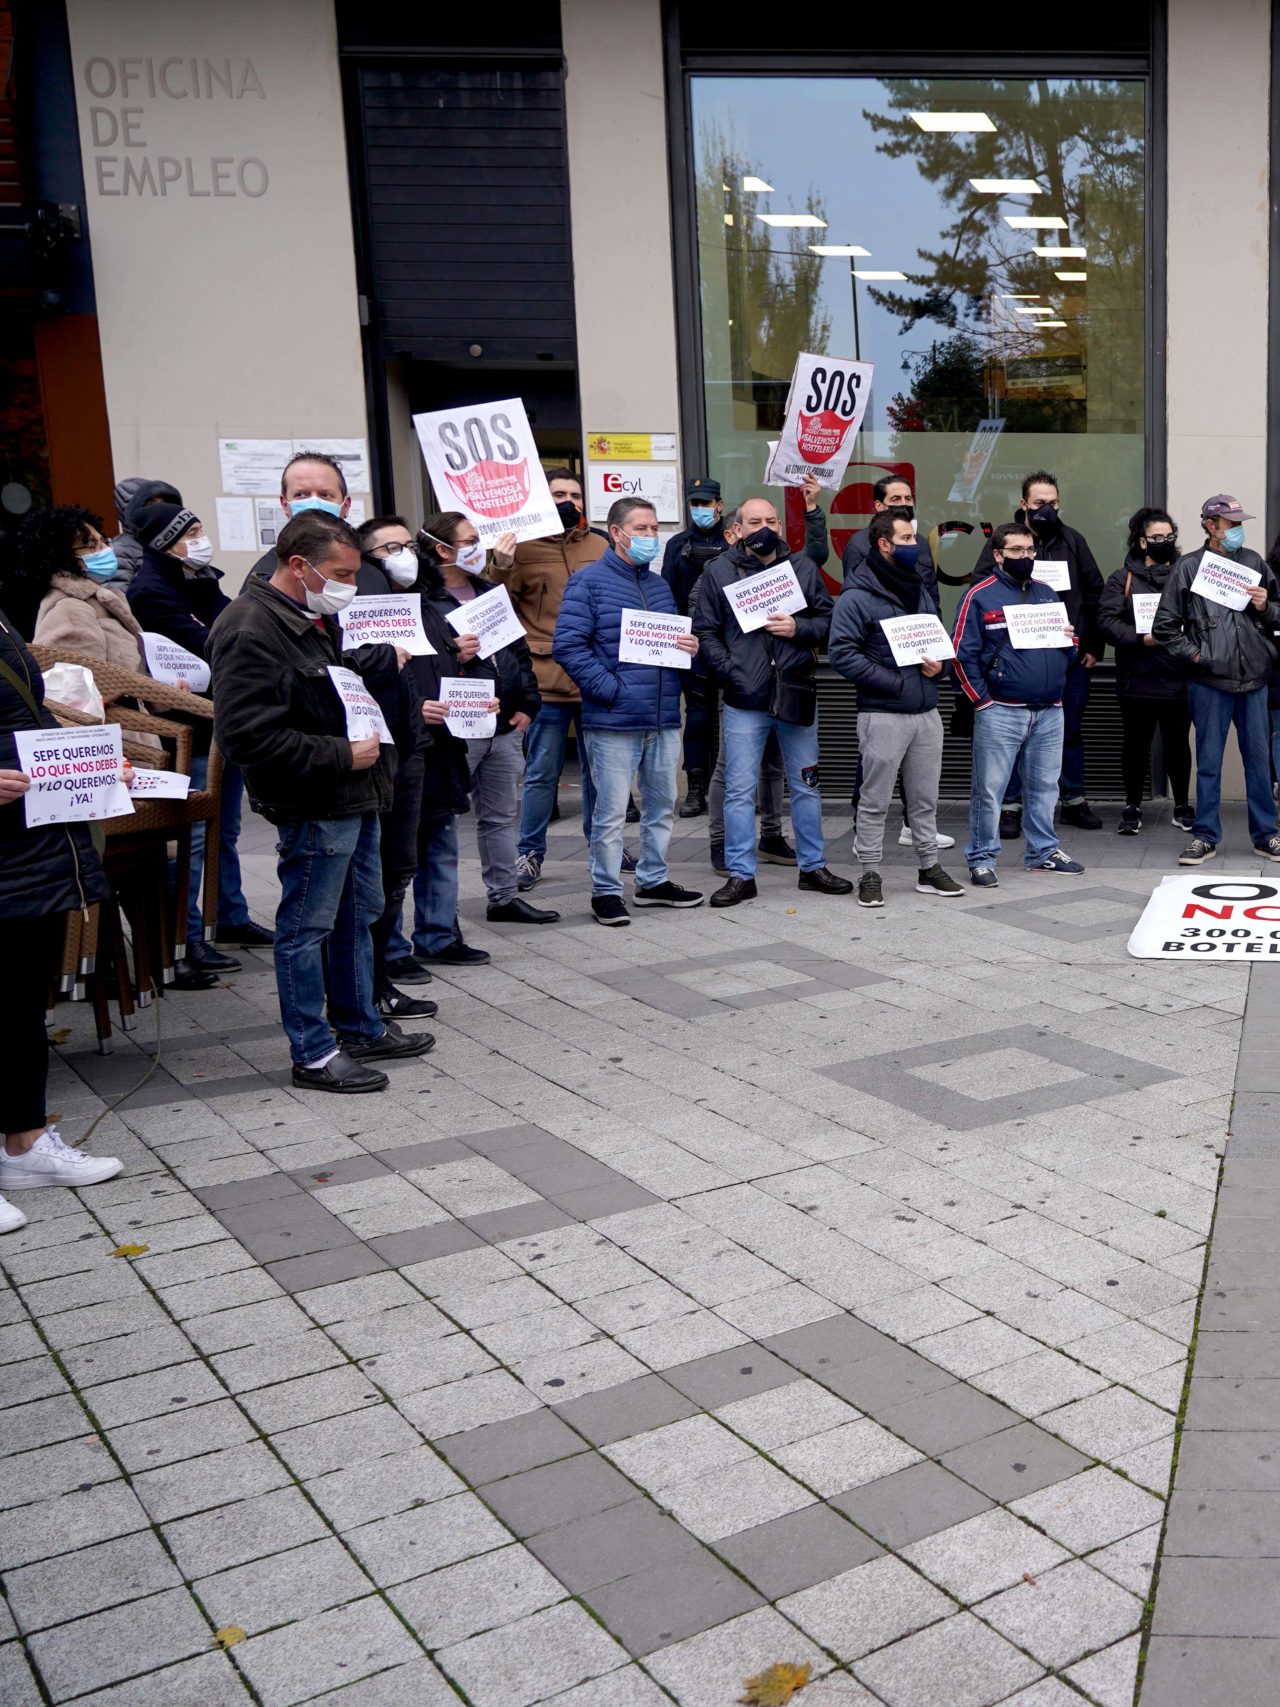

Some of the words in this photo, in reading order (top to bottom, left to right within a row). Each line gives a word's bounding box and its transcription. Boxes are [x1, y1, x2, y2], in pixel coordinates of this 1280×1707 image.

[84, 57, 266, 99] OFICINA
[90, 106, 147, 147] DE
[95, 156, 268, 198] EMPLEO
[806, 368, 861, 416] SOS
[438, 413, 520, 470] SOS
[784, 464, 790, 473] NO
[791, 465, 806, 474] SOMOS
[479, 522, 502, 536] SOMOS
[502, 521, 509, 532] EL
[509, 513, 543, 529] PROBLEMA
[736, 588, 752, 600] SEPE
[752, 574, 788, 593] QUEREMOS
[736, 601, 745, 609] LO
[746, 595, 760, 604] QUE
[760, 589, 775, 599] NOS
[775, 580, 794, 593] DEBES
[749, 605, 759, 613] LO
[759, 589, 793, 608] QUEREMOS
[767, 605, 780, 615] ¡YA!
[349, 610, 367, 619] SEPE
[368, 608, 411, 618] QUEREMOS
[345, 623, 355, 631] LO
[356, 621, 371, 630] QUE
[373, 620, 390, 628] NOS
[392, 619, 417, 627] DEBES
[350, 633, 355, 641] Y
[356, 632, 369, 641] LO
[370, 630, 415, 639] QUEREMOS
[647, 623, 686, 633] QUEREMOS
[33, 748, 61, 762] SEPE
[62, 744, 114, 760] QUEREMOS
[30, 766, 46, 779] LO
[47, 762, 70, 777] QUE
[73, 761, 94, 773] NOS
[95, 758, 118, 771] DEBES
[38, 781, 48, 792] Y
[47, 780, 62, 791] LO
[64, 774, 116, 790] QUEREMOS
[70, 793, 93, 807] ¡YA!
